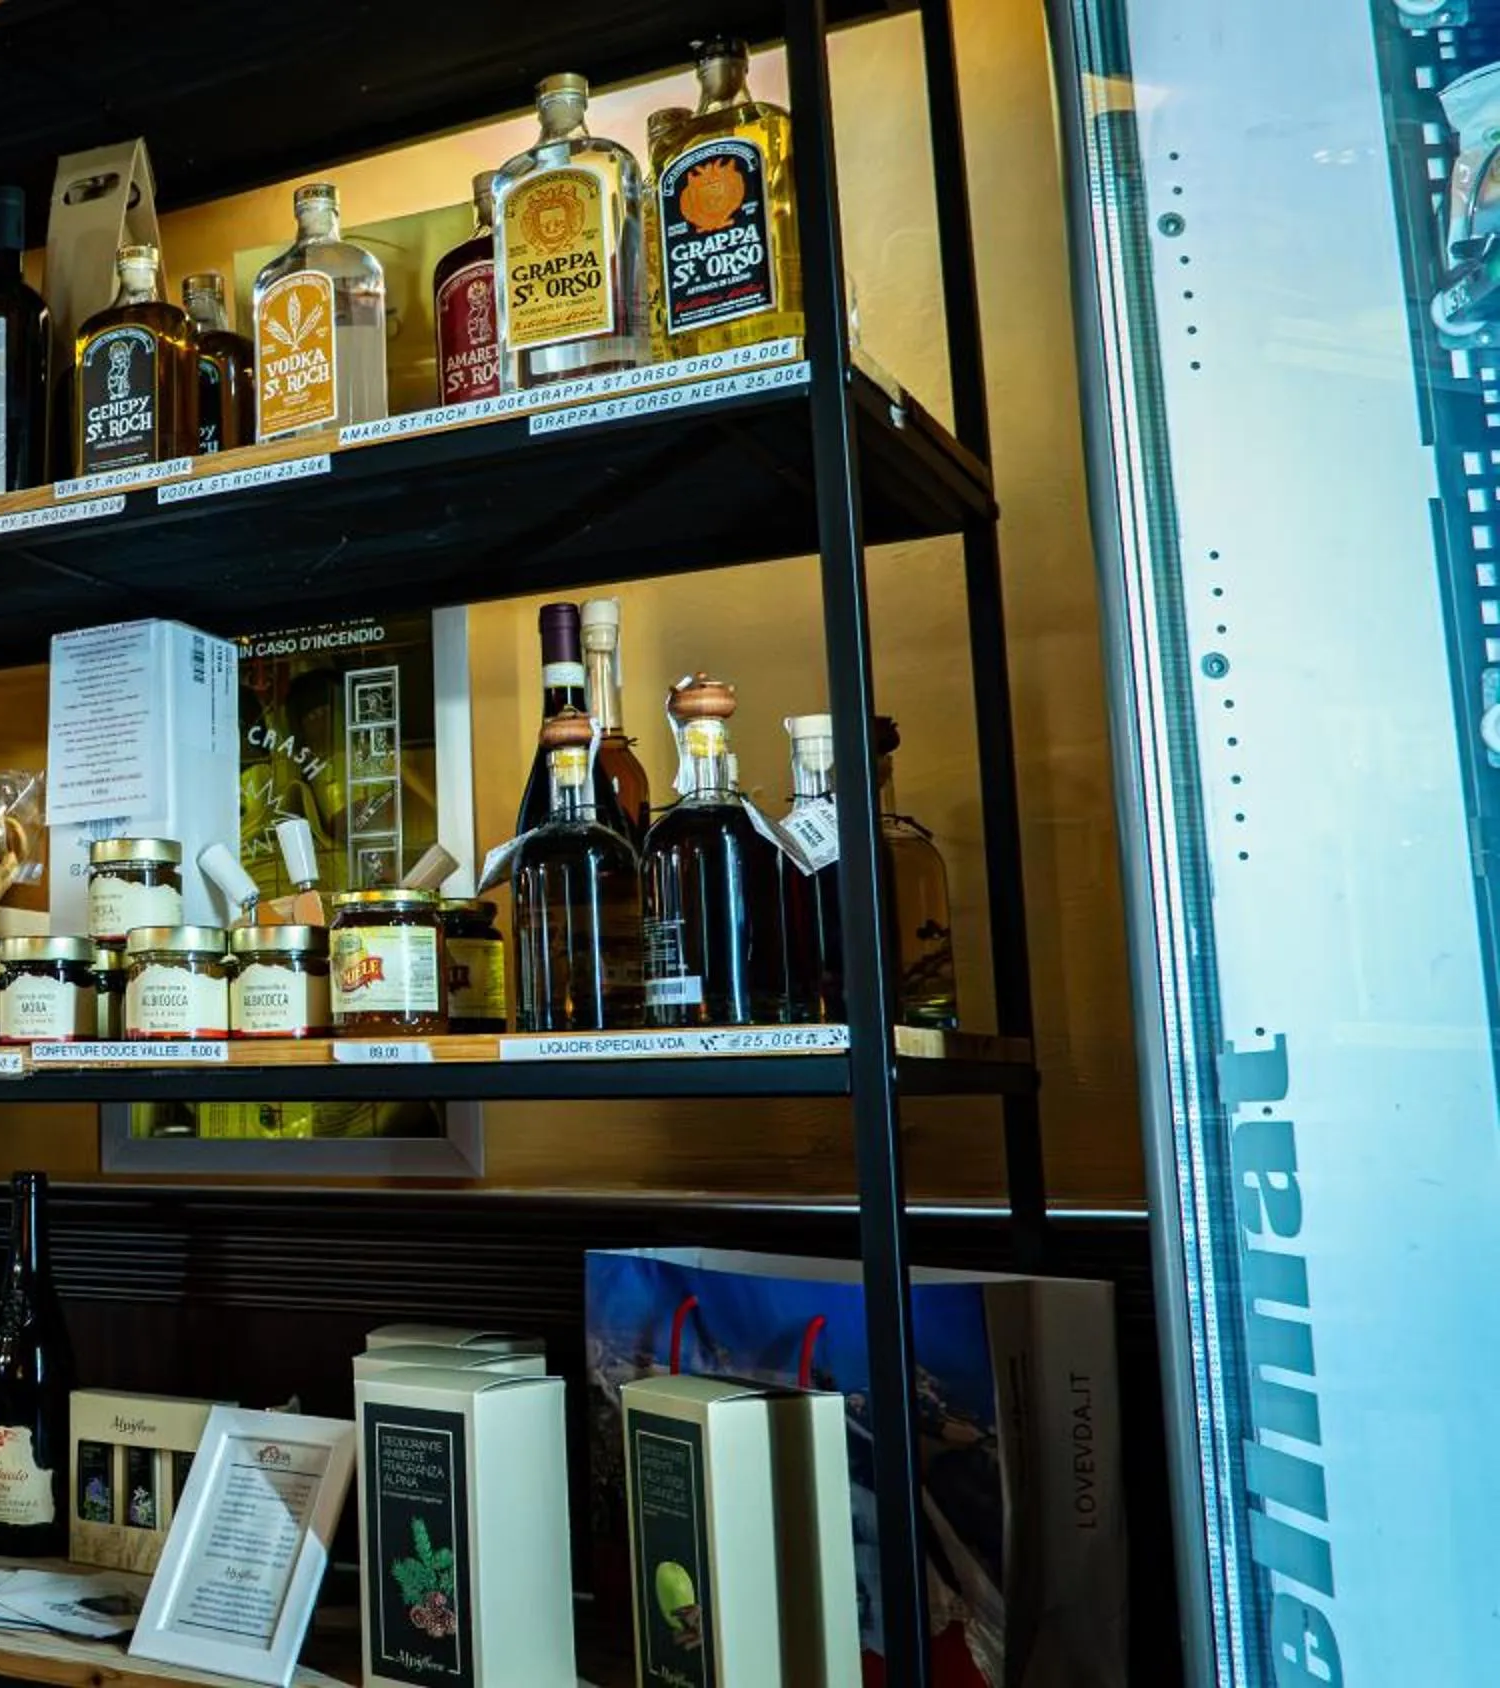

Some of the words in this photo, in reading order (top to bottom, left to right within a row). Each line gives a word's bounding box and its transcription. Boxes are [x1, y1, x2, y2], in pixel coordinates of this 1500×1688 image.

[671, 223, 761, 262] GRAPPA
[511, 250, 599, 283] GRAPPA
[706, 243, 764, 277] ORSO
[545, 269, 601, 298] ORSO
[265, 347, 328, 377] VODKA
[287, 363, 331, 392] ROCH
[529, 381, 595, 405] GRAPPA
[686, 355, 723, 373] ORO
[88, 395, 151, 421] GENEPY
[532, 408, 598, 431] GRAPPA
[691, 381, 738, 400] NERA
[109, 411, 153, 438] ROCH
[340, 421, 392, 441] AMARO
[160, 482, 203, 499] VODKA
[255, 640, 297, 658] CASO
[300, 626, 385, 650] D'INCENDIO
[247, 725, 327, 781] CRASH
[141, 994, 189, 1007] ALBICOCCA
[34, 1045, 100, 1058] CONFETTURE
[101, 1045, 139, 1058] DOUCE
[539, 1040, 593, 1055] LIQUORI
[596, 1038, 654, 1053] SPECIALI
[658, 1037, 685, 1051] VDA
[381, 1435, 443, 1453] DEODORANTE
[381, 1447, 425, 1462] AMBIENTE
[1069, 1372, 1097, 1530] LOVEVDA.IT
